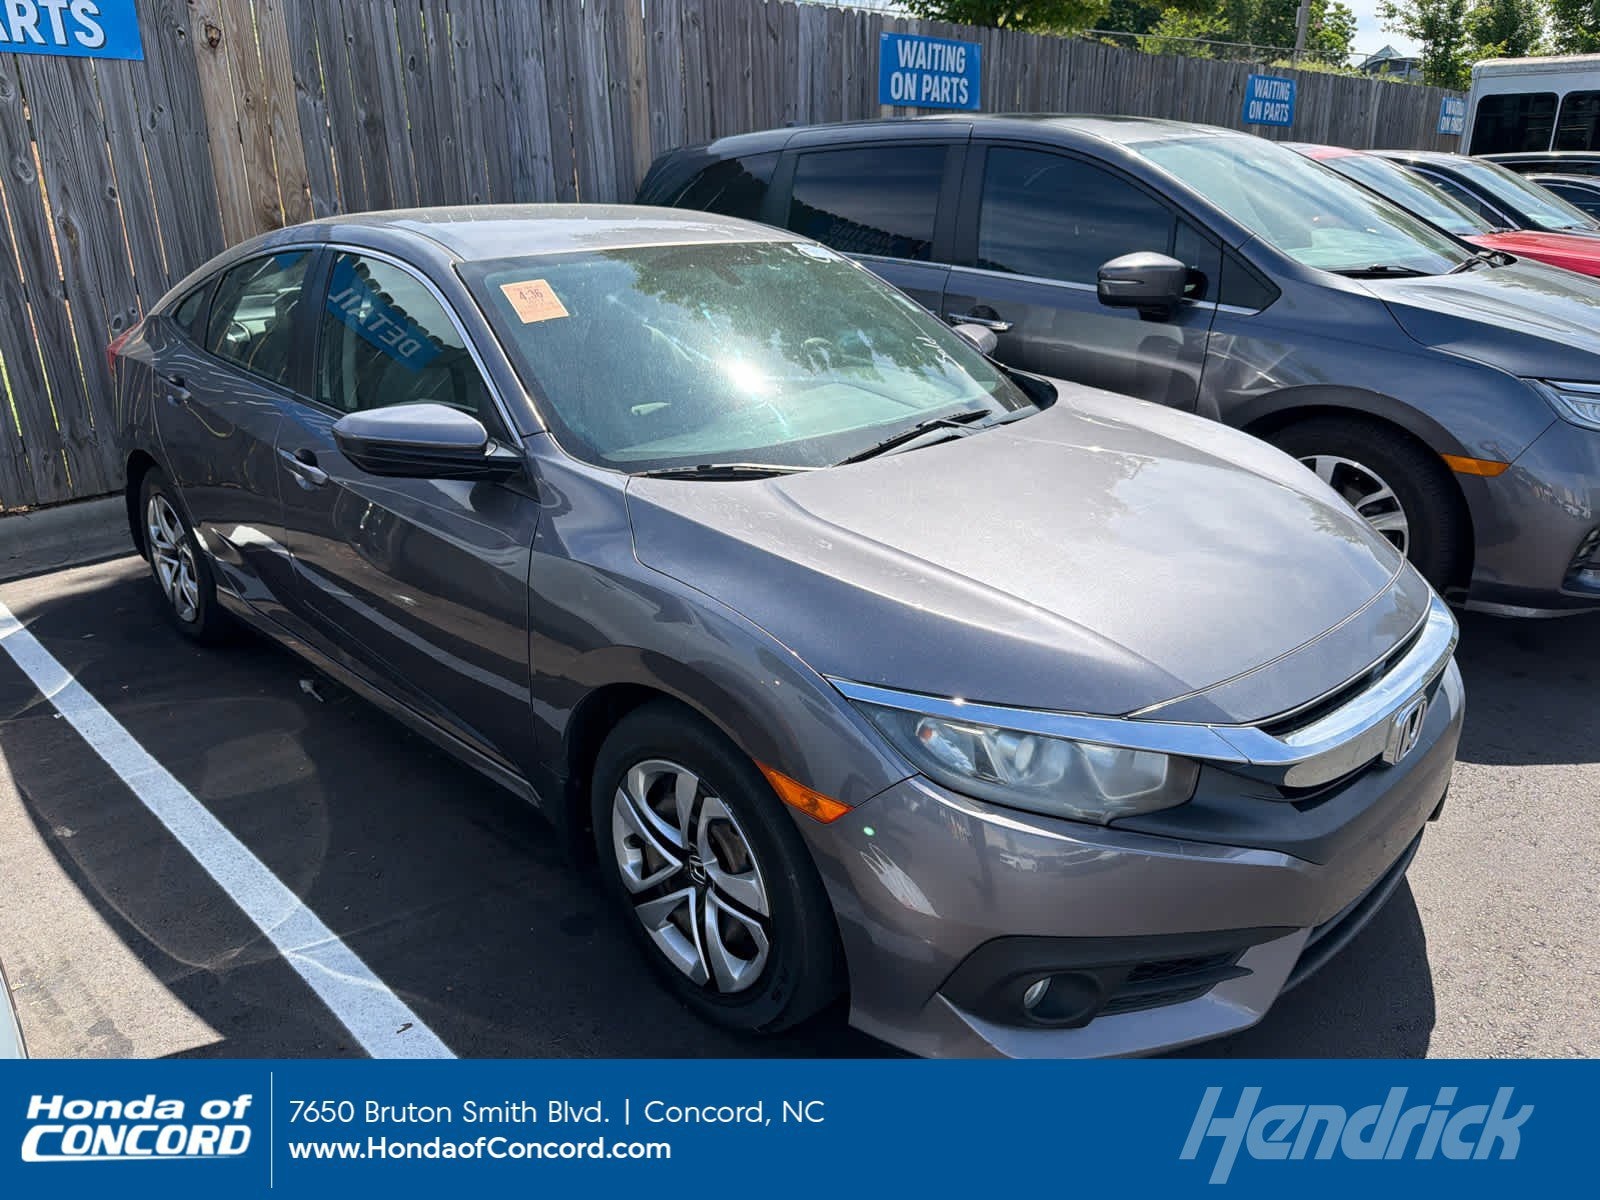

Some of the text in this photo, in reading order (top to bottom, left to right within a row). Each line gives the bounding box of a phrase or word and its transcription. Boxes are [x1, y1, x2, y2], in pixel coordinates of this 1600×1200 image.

[0, 0, 105, 48] RTS
[897, 39, 966, 74] WAITING
[890, 71, 969, 105] ON PARTS
[1254, 79, 1290, 101] WAITING
[1249, 100, 1289, 122] ON PARTS
